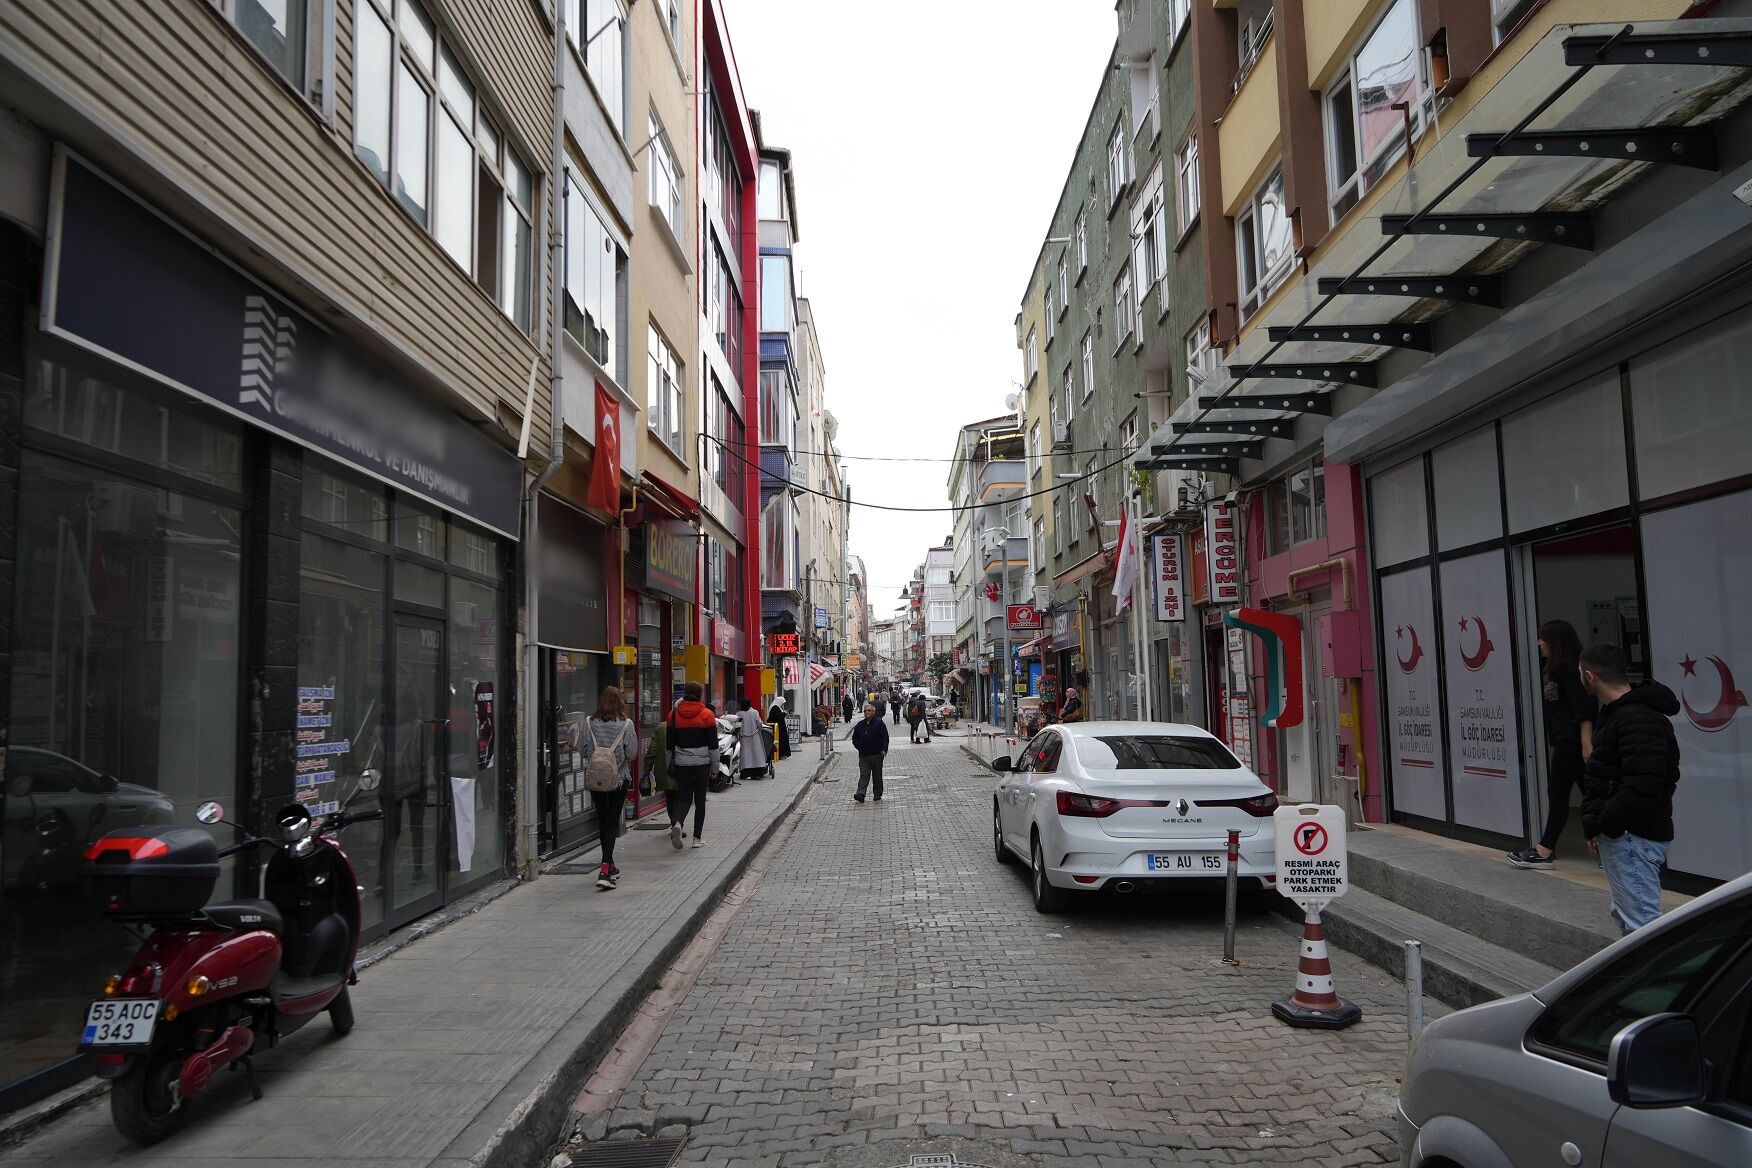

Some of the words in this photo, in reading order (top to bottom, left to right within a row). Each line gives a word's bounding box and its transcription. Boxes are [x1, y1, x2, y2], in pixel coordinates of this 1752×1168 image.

[1213, 504, 1238, 597] TERCÜME
[1161, 538, 1178, 581] OTURUM
[777, 633, 796, 641] UCUZ
[776, 645, 798, 654] KİTAP
[1467, 723, 1479, 745] GÖÇ
[1480, 724, 1506, 743] İDARESİ
[1155, 856, 1170, 869] 55
[1177, 856, 1192, 868] AU
[1201, 856, 1221, 869] 155
[1284, 859, 1313, 868] RESMİ
[1315, 860, 1341, 870] ARAÇ
[1284, 877, 1309, 885] PARK
[1310, 877, 1343, 885] ETMEK
[91, 1004, 115, 1021] 55
[117, 1003, 155, 1020] AOC
[98, 1023, 135, 1041] 343
